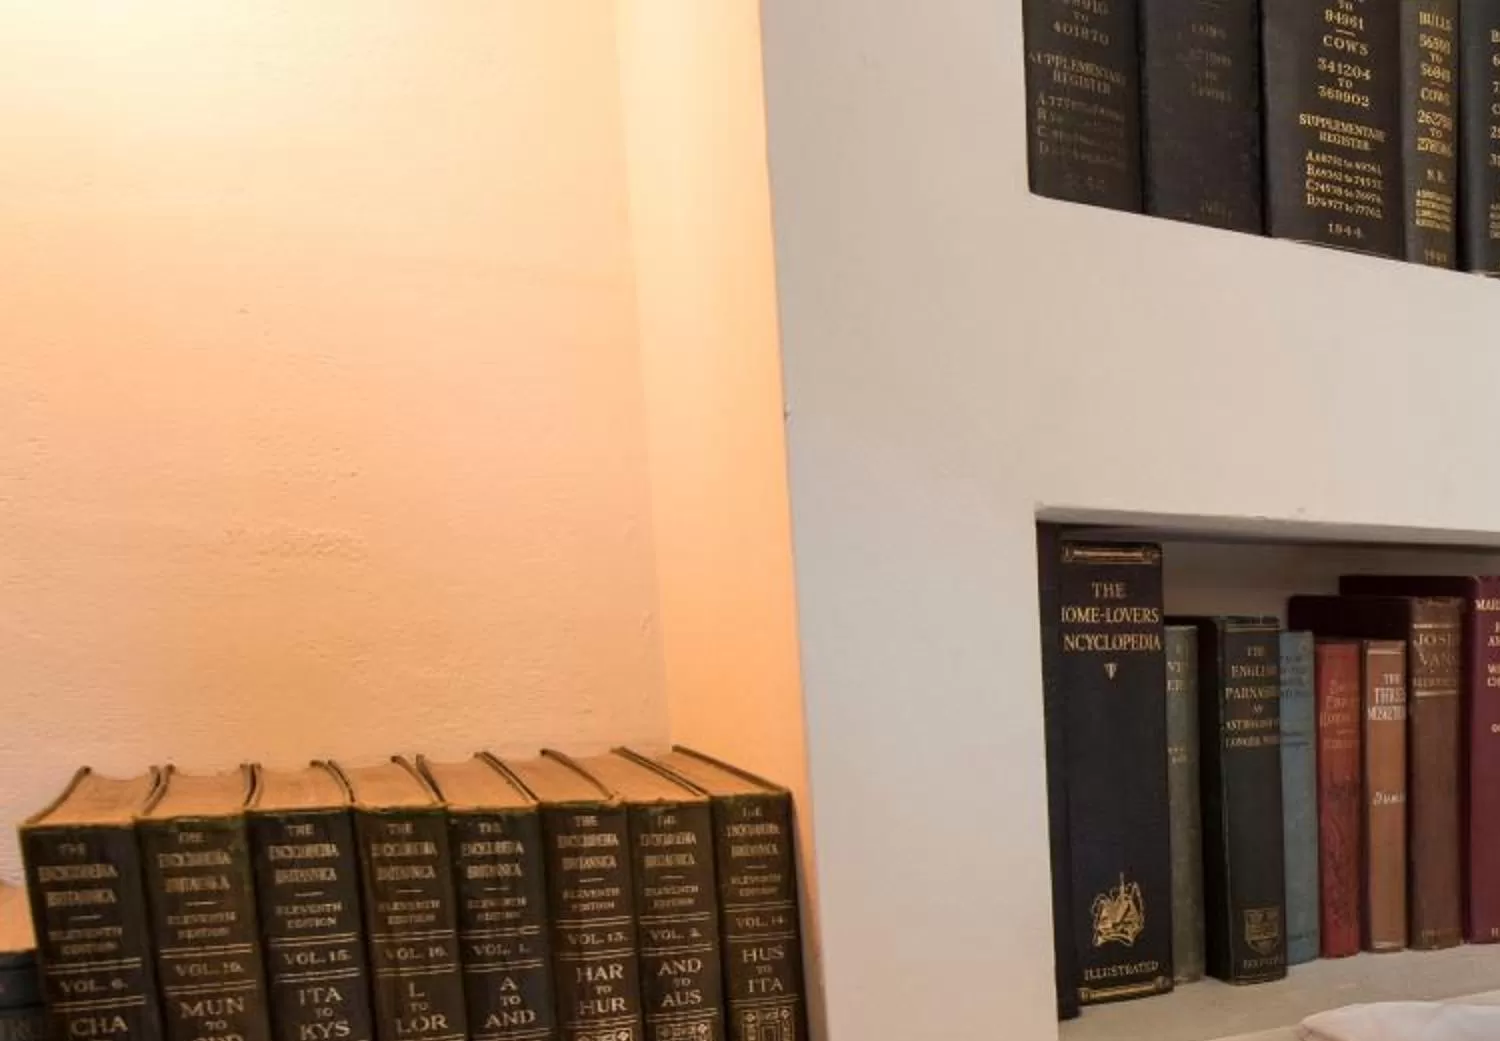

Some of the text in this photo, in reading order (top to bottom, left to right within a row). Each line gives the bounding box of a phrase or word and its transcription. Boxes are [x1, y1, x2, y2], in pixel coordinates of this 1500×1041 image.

[1322, 34, 1370, 57] COWS
[1091, 581, 1127, 599] THE
[1062, 632, 1162, 653] NCYCLOPEDIA
[742, 944, 785, 963] HUS
[576, 962, 625, 983] HAR
[657, 957, 705, 977] AND
[1083, 959, 1160, 981] ILLUSTRATED
[407, 981, 426, 998] L
[499, 976, 519, 993] A
[747, 977, 785, 995] ITA
[298, 985, 345, 1006] ITA
[660, 988, 703, 1008] AUS
[178, 996, 246, 1019] MUN
[579, 997, 628, 1016] HUR
[70, 1014, 130, 1037] CHA
[299, 1020, 353, 1041] KYS
[394, 1013, 449, 1035] LOR
[483, 1009, 537, 1031] AND
